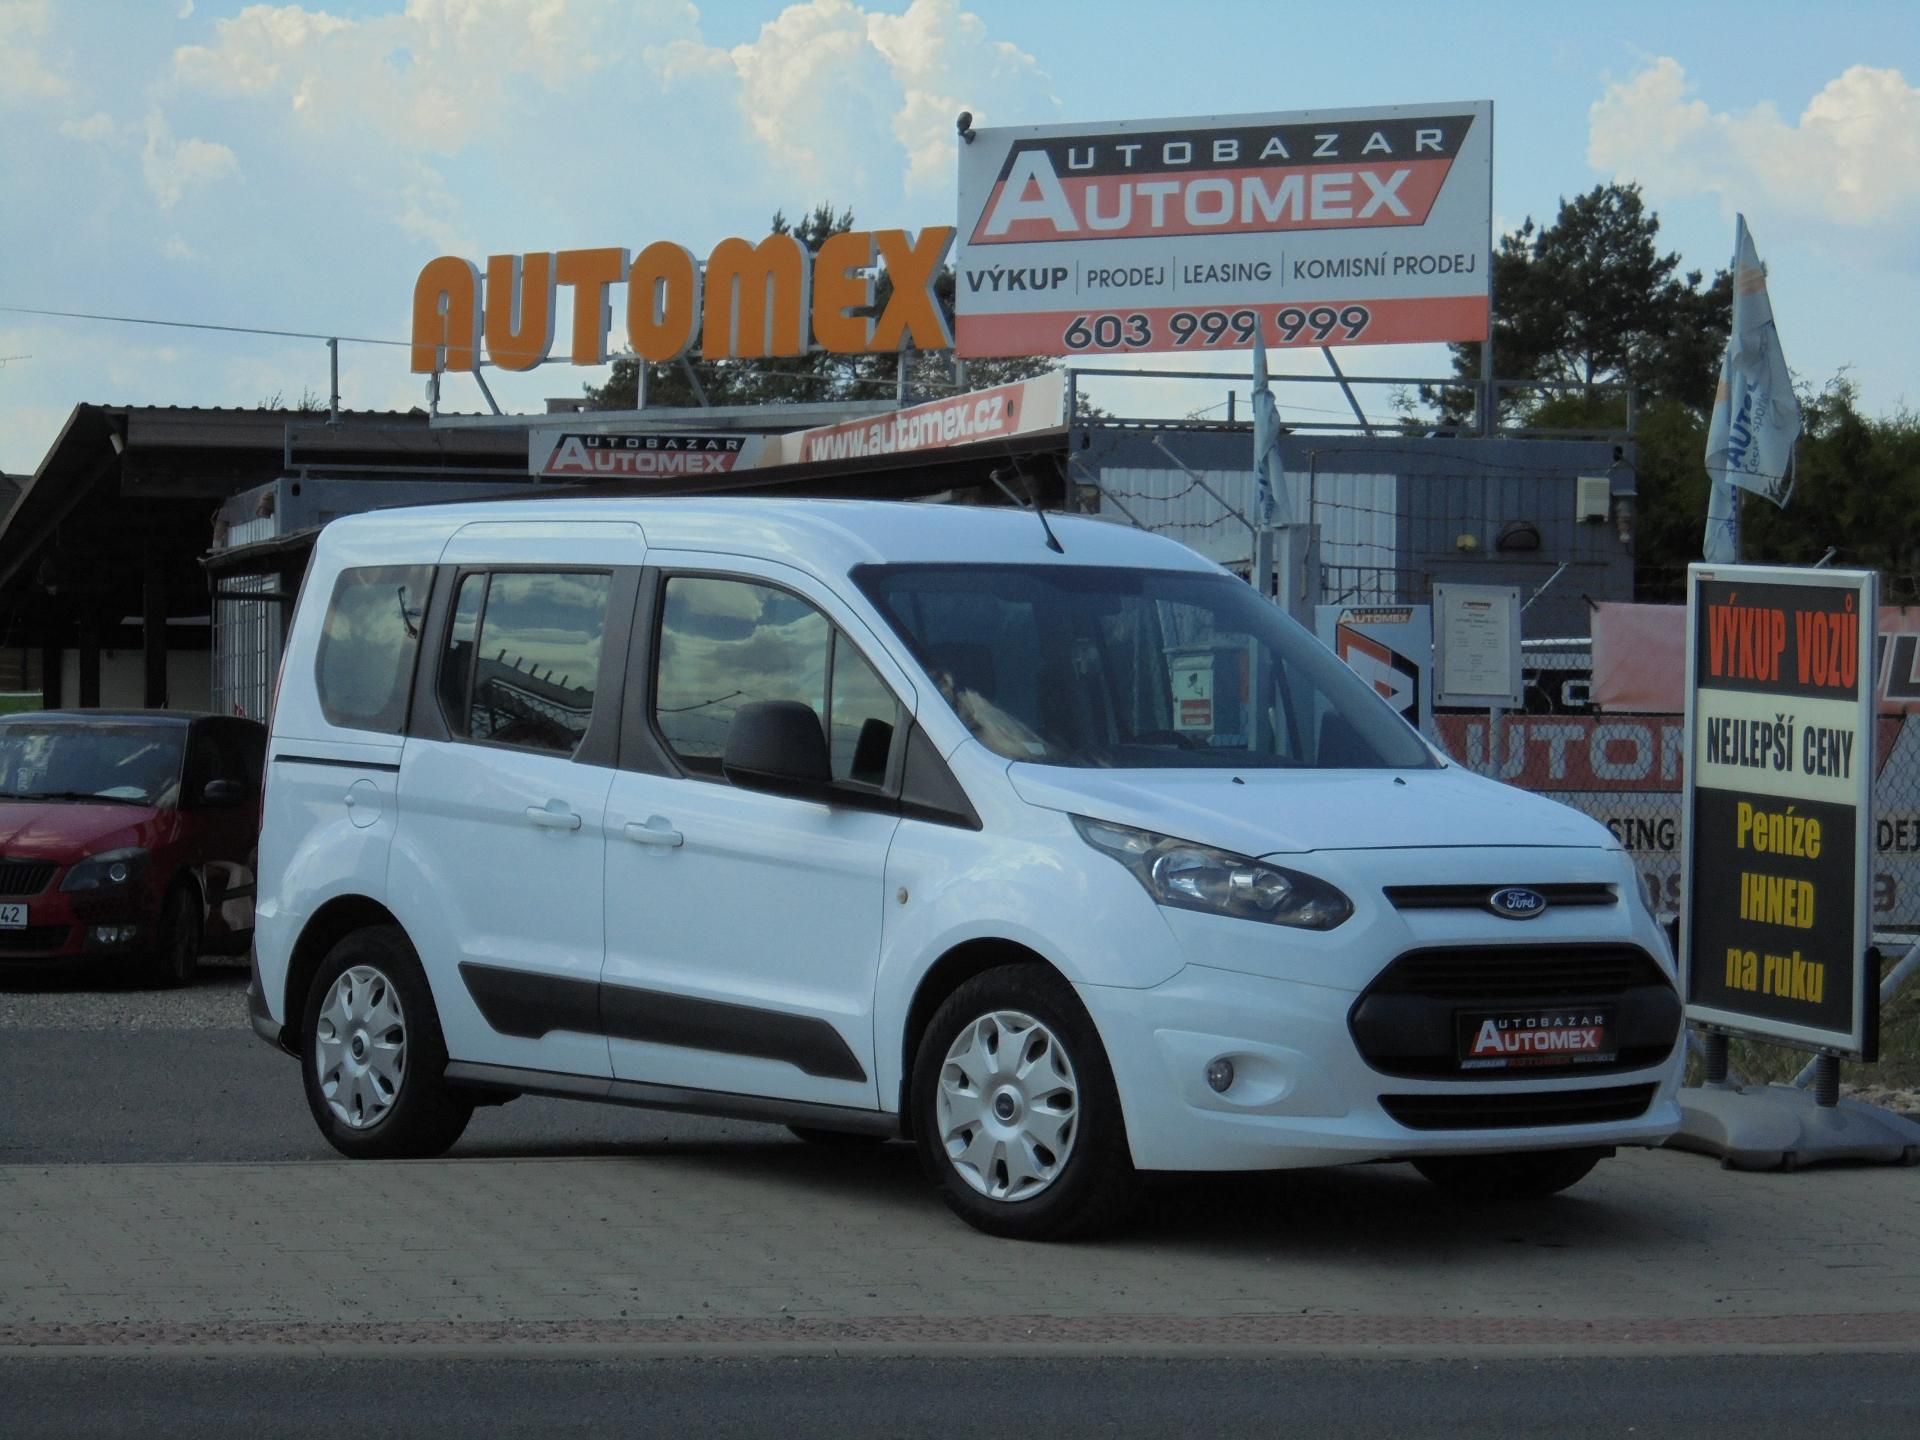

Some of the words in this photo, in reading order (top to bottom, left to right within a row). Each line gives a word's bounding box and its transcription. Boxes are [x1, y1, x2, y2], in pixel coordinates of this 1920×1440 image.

[983, 150, 1412, 236] AUTOMEX
[411, 226, 957, 374] AUTOMEX
[966, 264, 1069, 294] VÝKUP
[1086, 266, 1165, 290] PRODEJ
[1182, 261, 1273, 285] LEASING
[1292, 251, 1388, 281] KOMISNÍ
[1393, 254, 1477, 277] PRODEJ
[1063, 313, 1152, 350] 603
[1168, 310, 1259, 346] 999
[1276, 305, 1371, 342] 999
[551, 436, 727, 473] AUTOMEX
[811, 395, 1004, 463] www.automex.cz
[1708, 592, 1786, 682] VÝKUP
[1796, 593, 1858, 690] VOZŮ
[1706, 713, 1794, 773] NEJLEPŠÍ
[1802, 728, 1854, 780] CENY
[1737, 801, 1821, 860] Peníze
[1506, 893, 1536, 909] Ford
[1740, 872, 1814, 930] IHNED
[1726, 948, 1757, 993] na
[1763, 950, 1824, 1003] ruku
[1475, 1020, 1597, 1053] AUTOMEX
